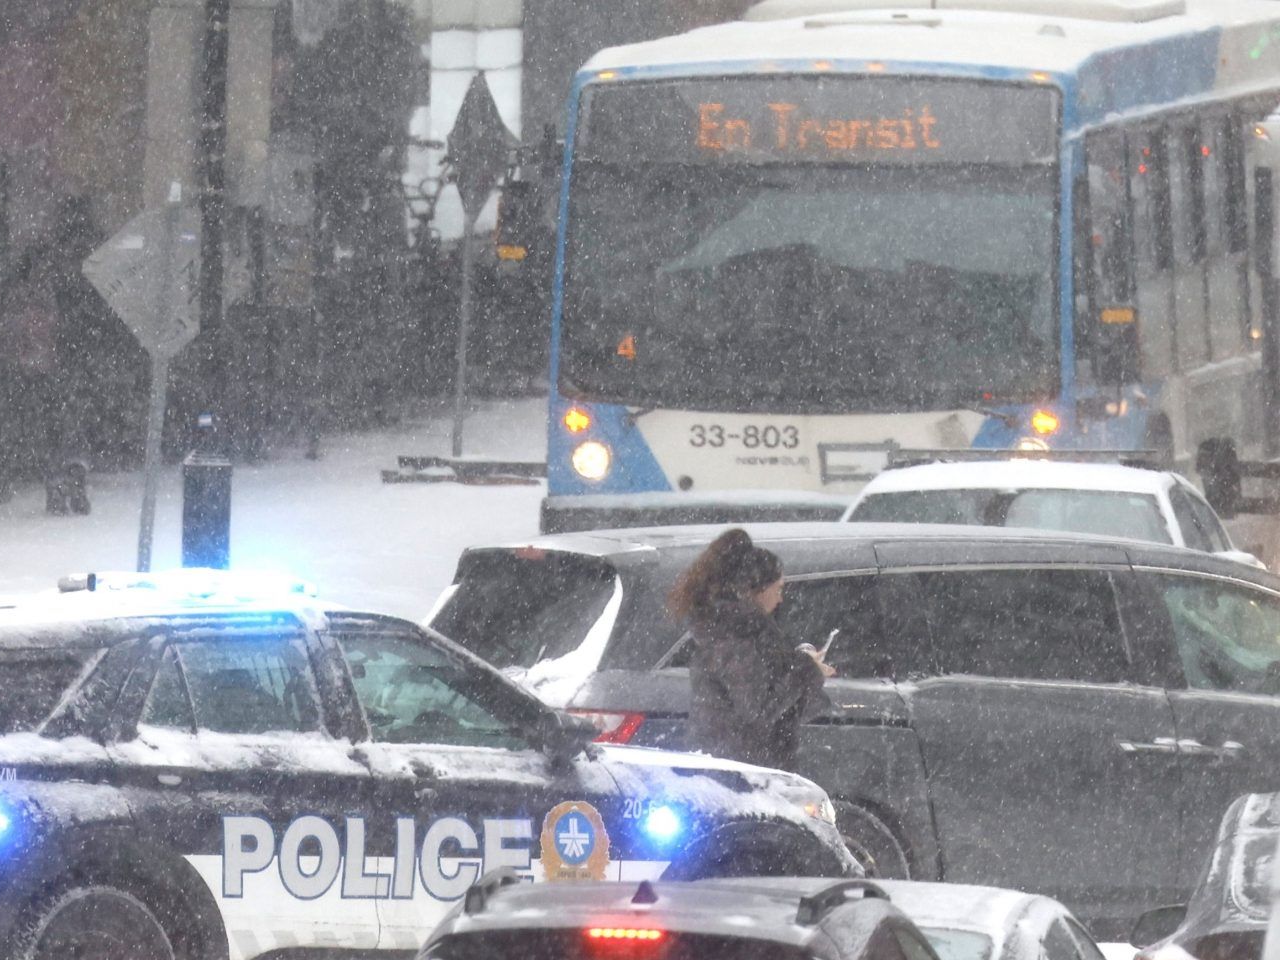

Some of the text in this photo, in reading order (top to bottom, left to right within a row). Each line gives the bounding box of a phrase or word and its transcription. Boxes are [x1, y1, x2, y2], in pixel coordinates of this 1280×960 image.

[696, 103, 941, 150] En Transit
[689, 424, 799, 449] 33-803
[221, 815, 534, 901] POLICE
